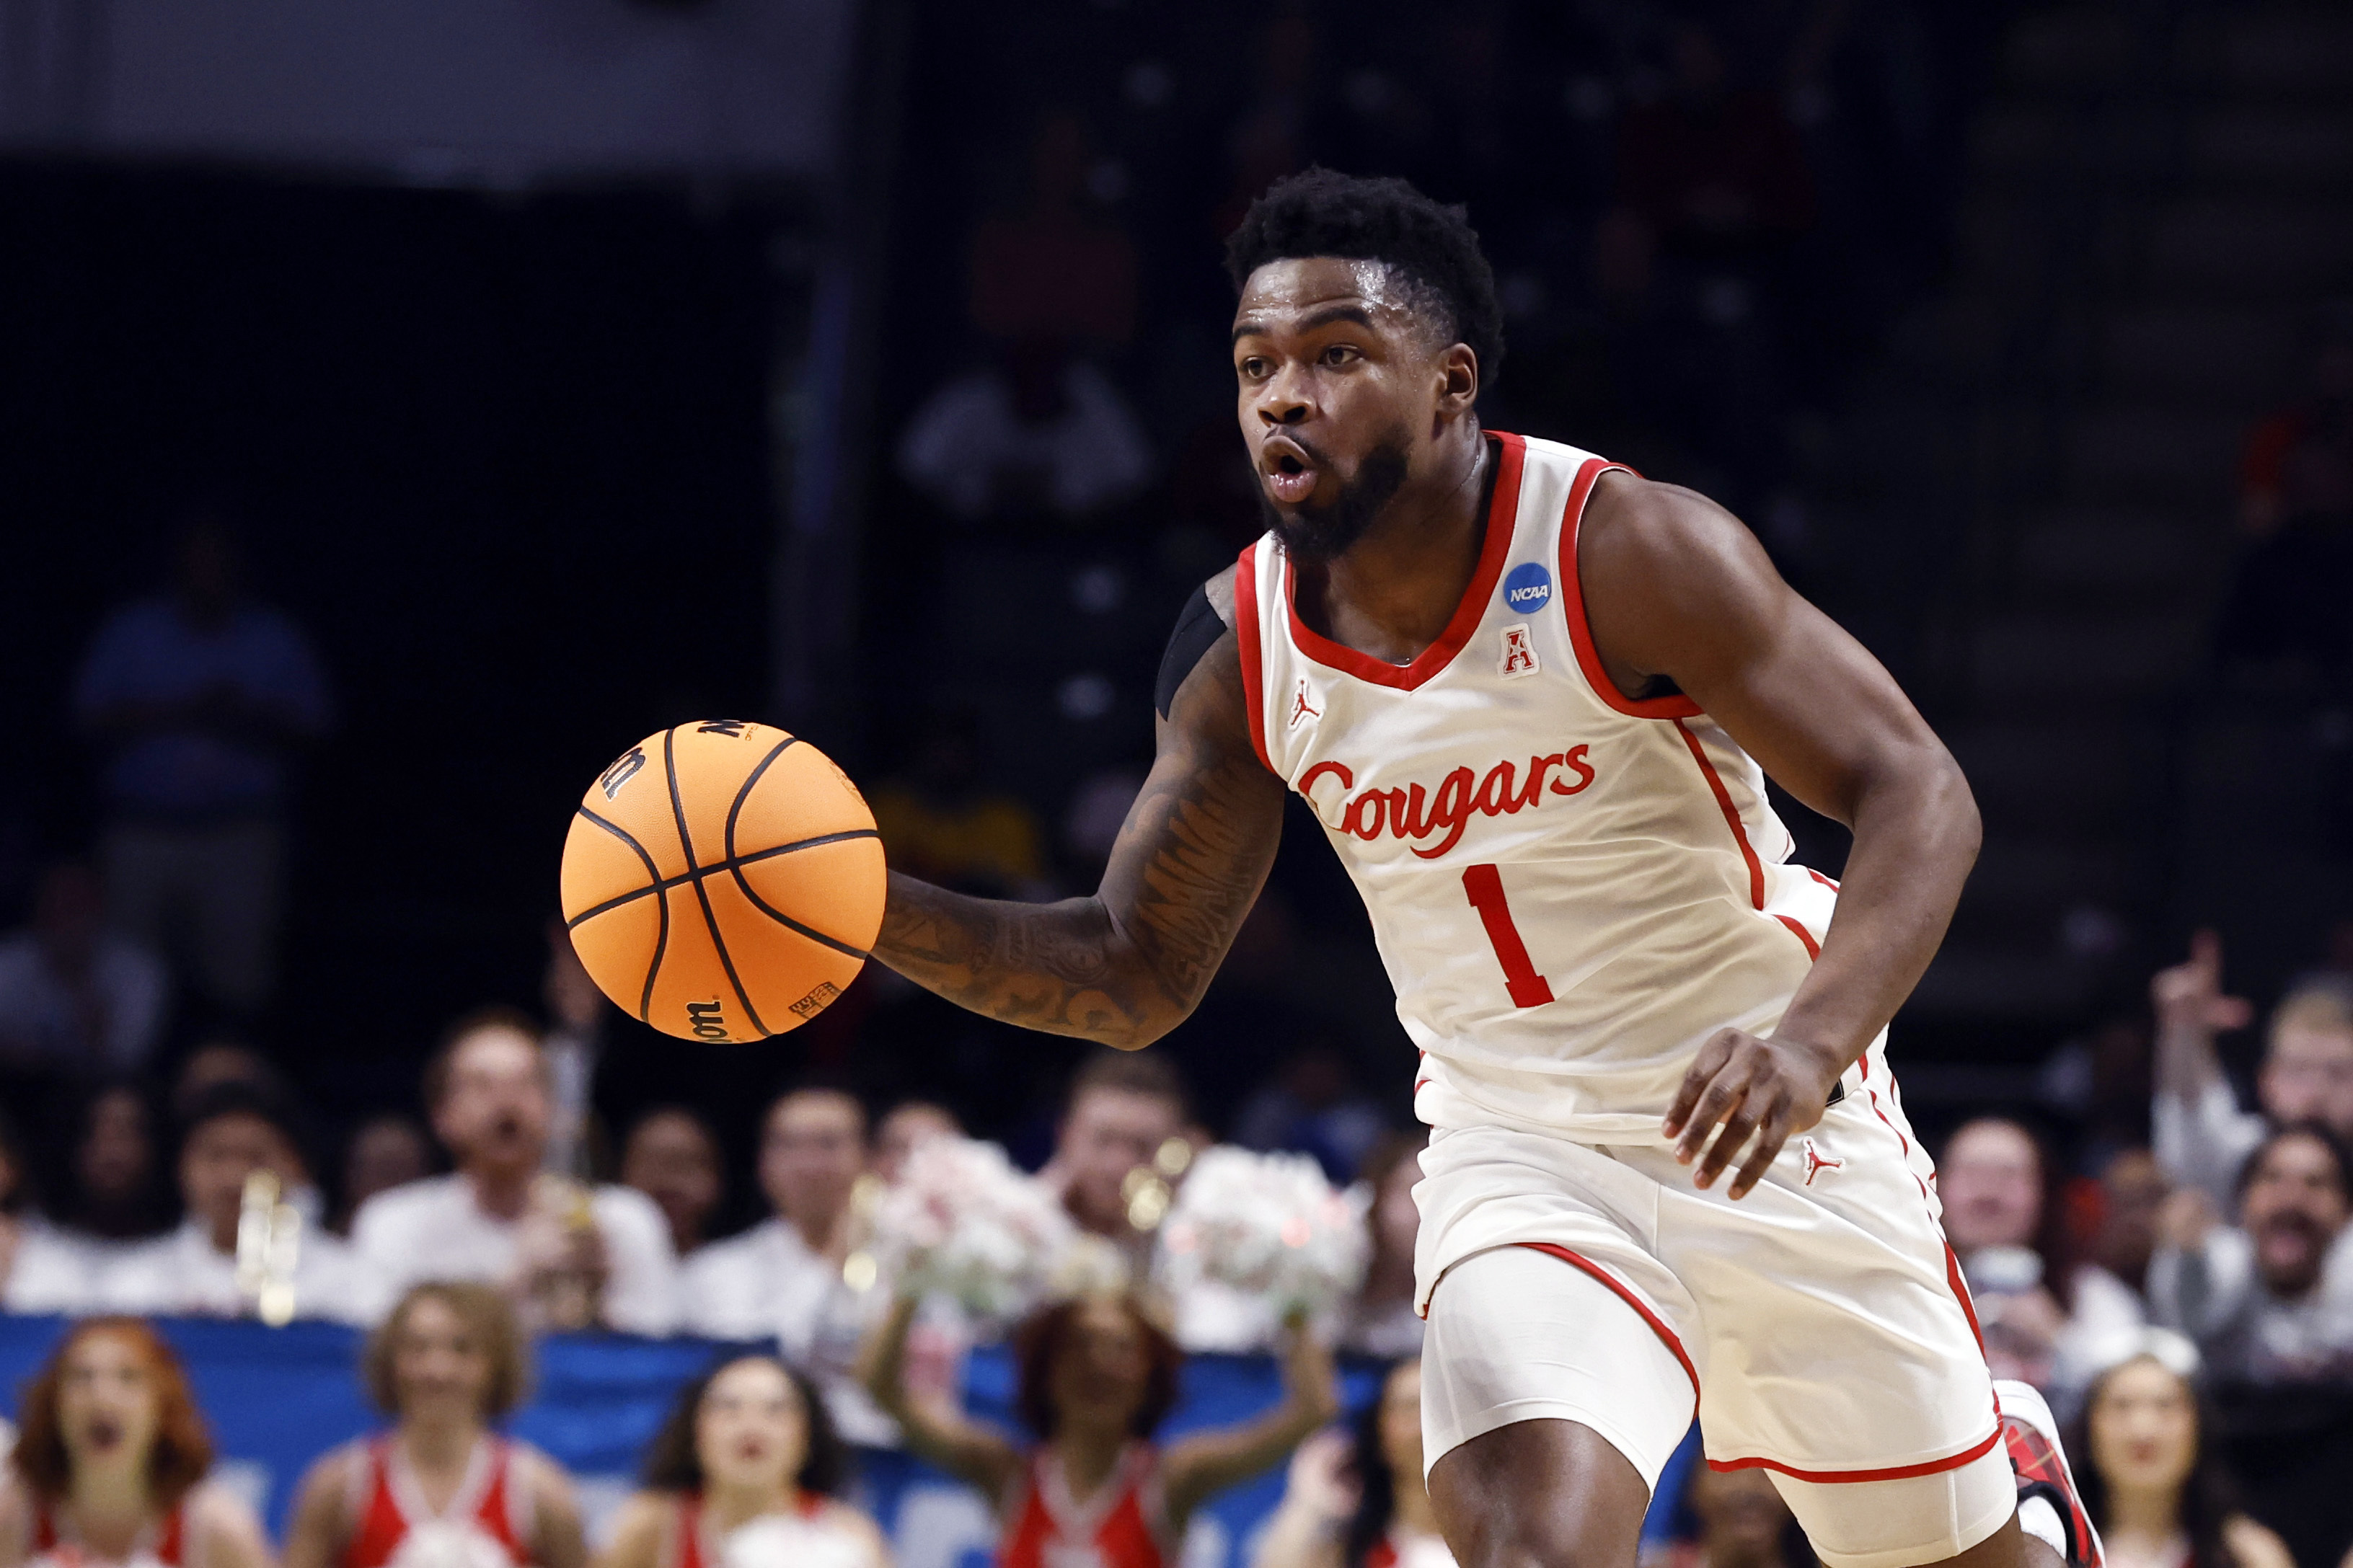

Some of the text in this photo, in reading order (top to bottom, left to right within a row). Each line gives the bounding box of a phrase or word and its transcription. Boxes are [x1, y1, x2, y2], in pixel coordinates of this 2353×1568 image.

[1511, 585, 1550, 603] NCAA
[1298, 744, 1595, 859] Cougars
[1462, 864, 1555, 1009] 1
[685, 999, 730, 1042] on
